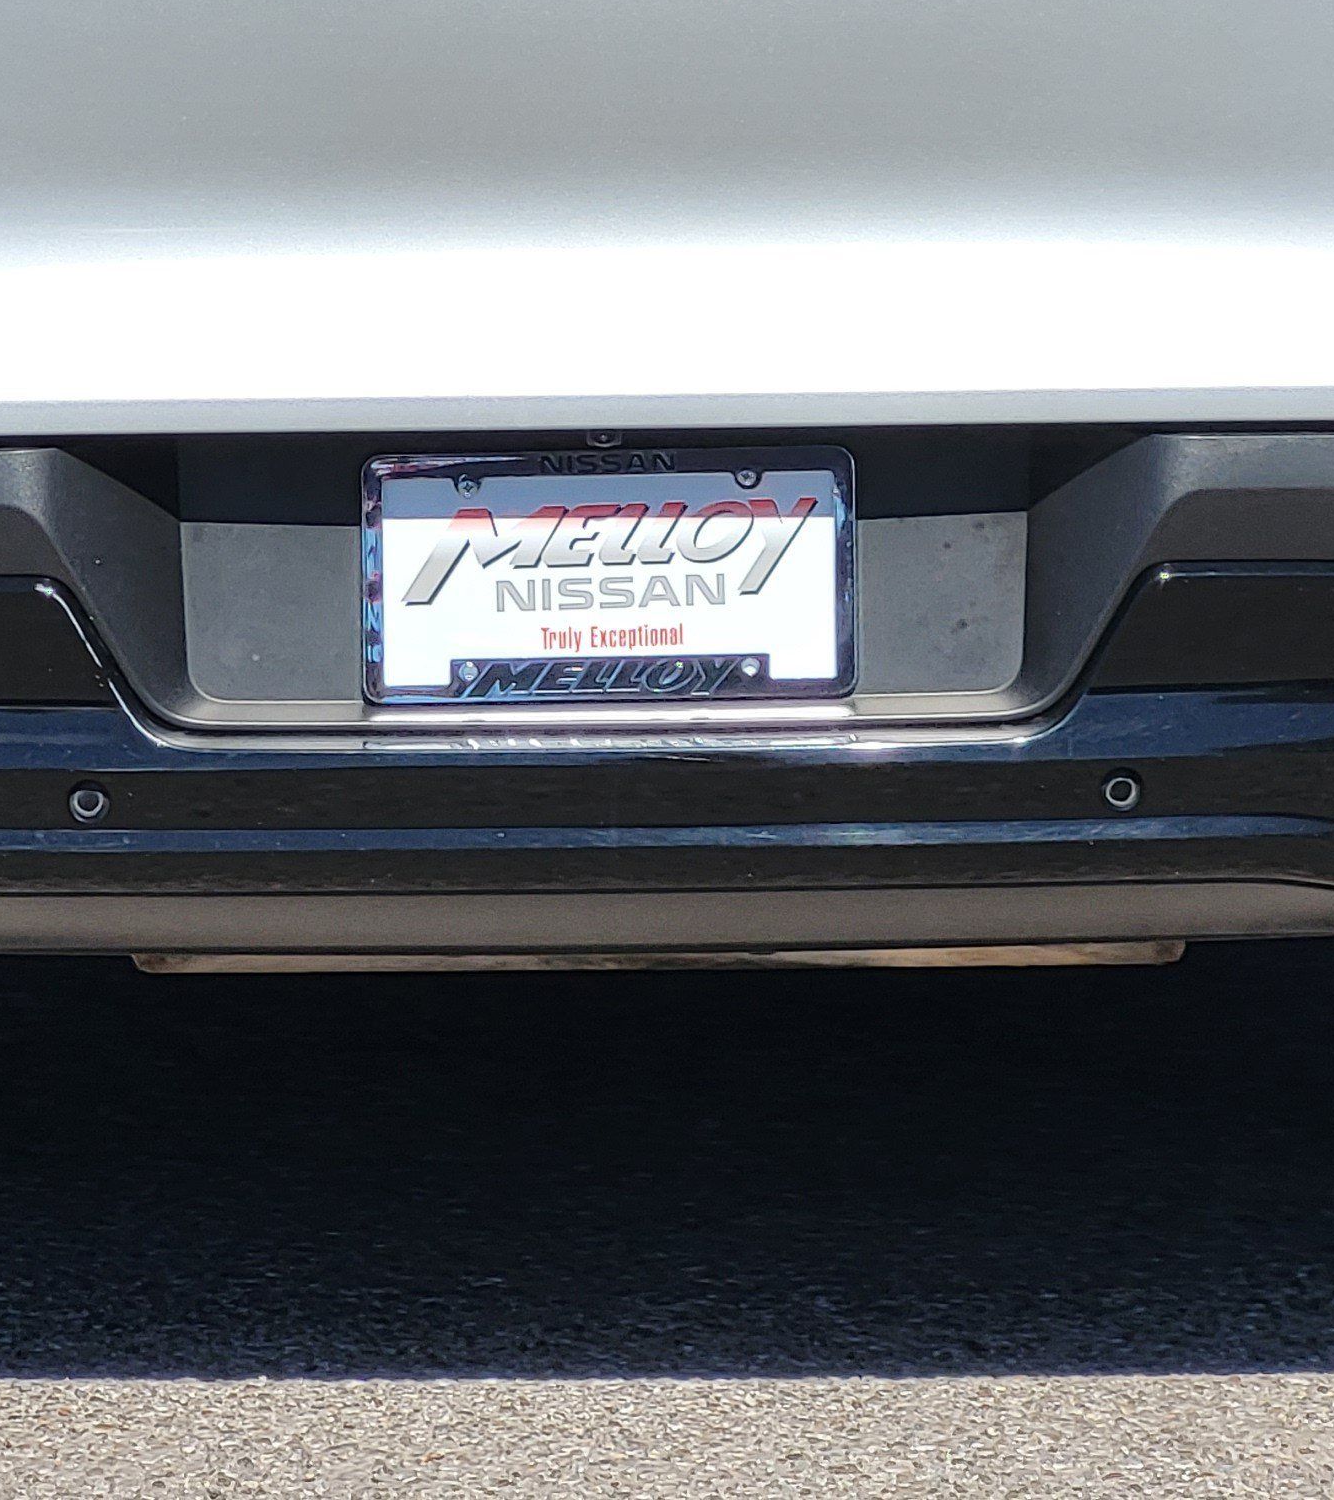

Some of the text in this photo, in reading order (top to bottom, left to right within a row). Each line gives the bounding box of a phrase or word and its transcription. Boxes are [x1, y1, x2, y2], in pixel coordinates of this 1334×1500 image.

[538, 453, 676, 474] NISSAN
[401, 497, 818, 606] MELLOY
[496, 573, 726, 612] NISSAN
[541, 622, 684, 653] Truly Exceptional
[462, 658, 741, 697] MELLOY
